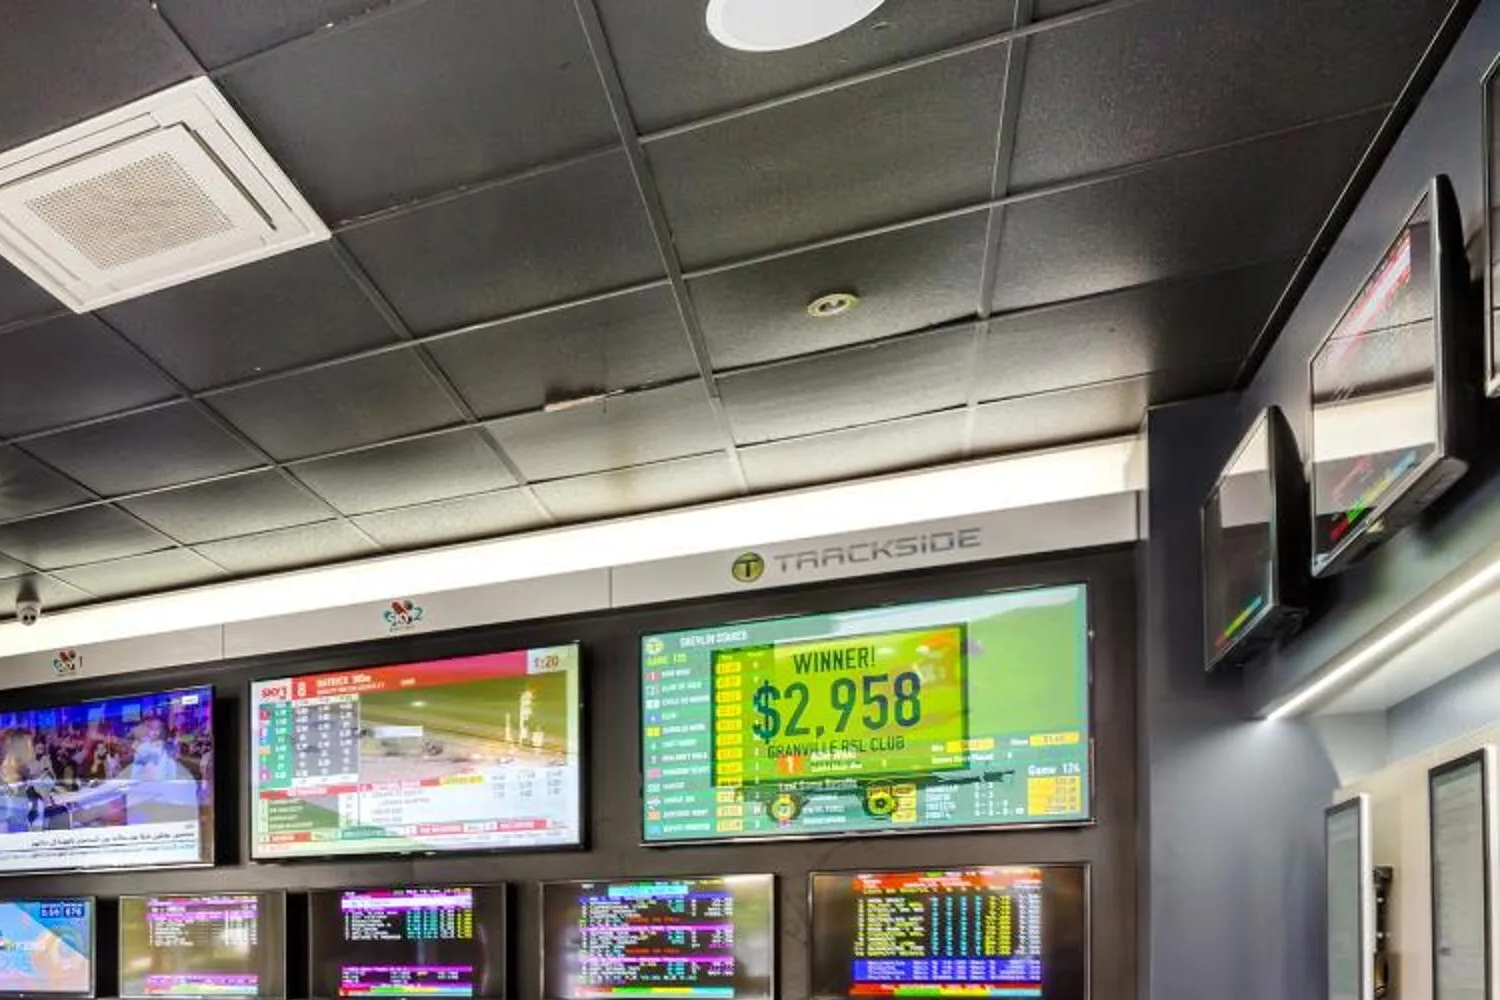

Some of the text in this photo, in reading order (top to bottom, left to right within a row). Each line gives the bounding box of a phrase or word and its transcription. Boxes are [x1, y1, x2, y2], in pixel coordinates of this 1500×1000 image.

[793, 646, 876, 674] WINNER!
[752, 671, 921, 744] $2,958
[869, 735, 905, 752] CLUB
